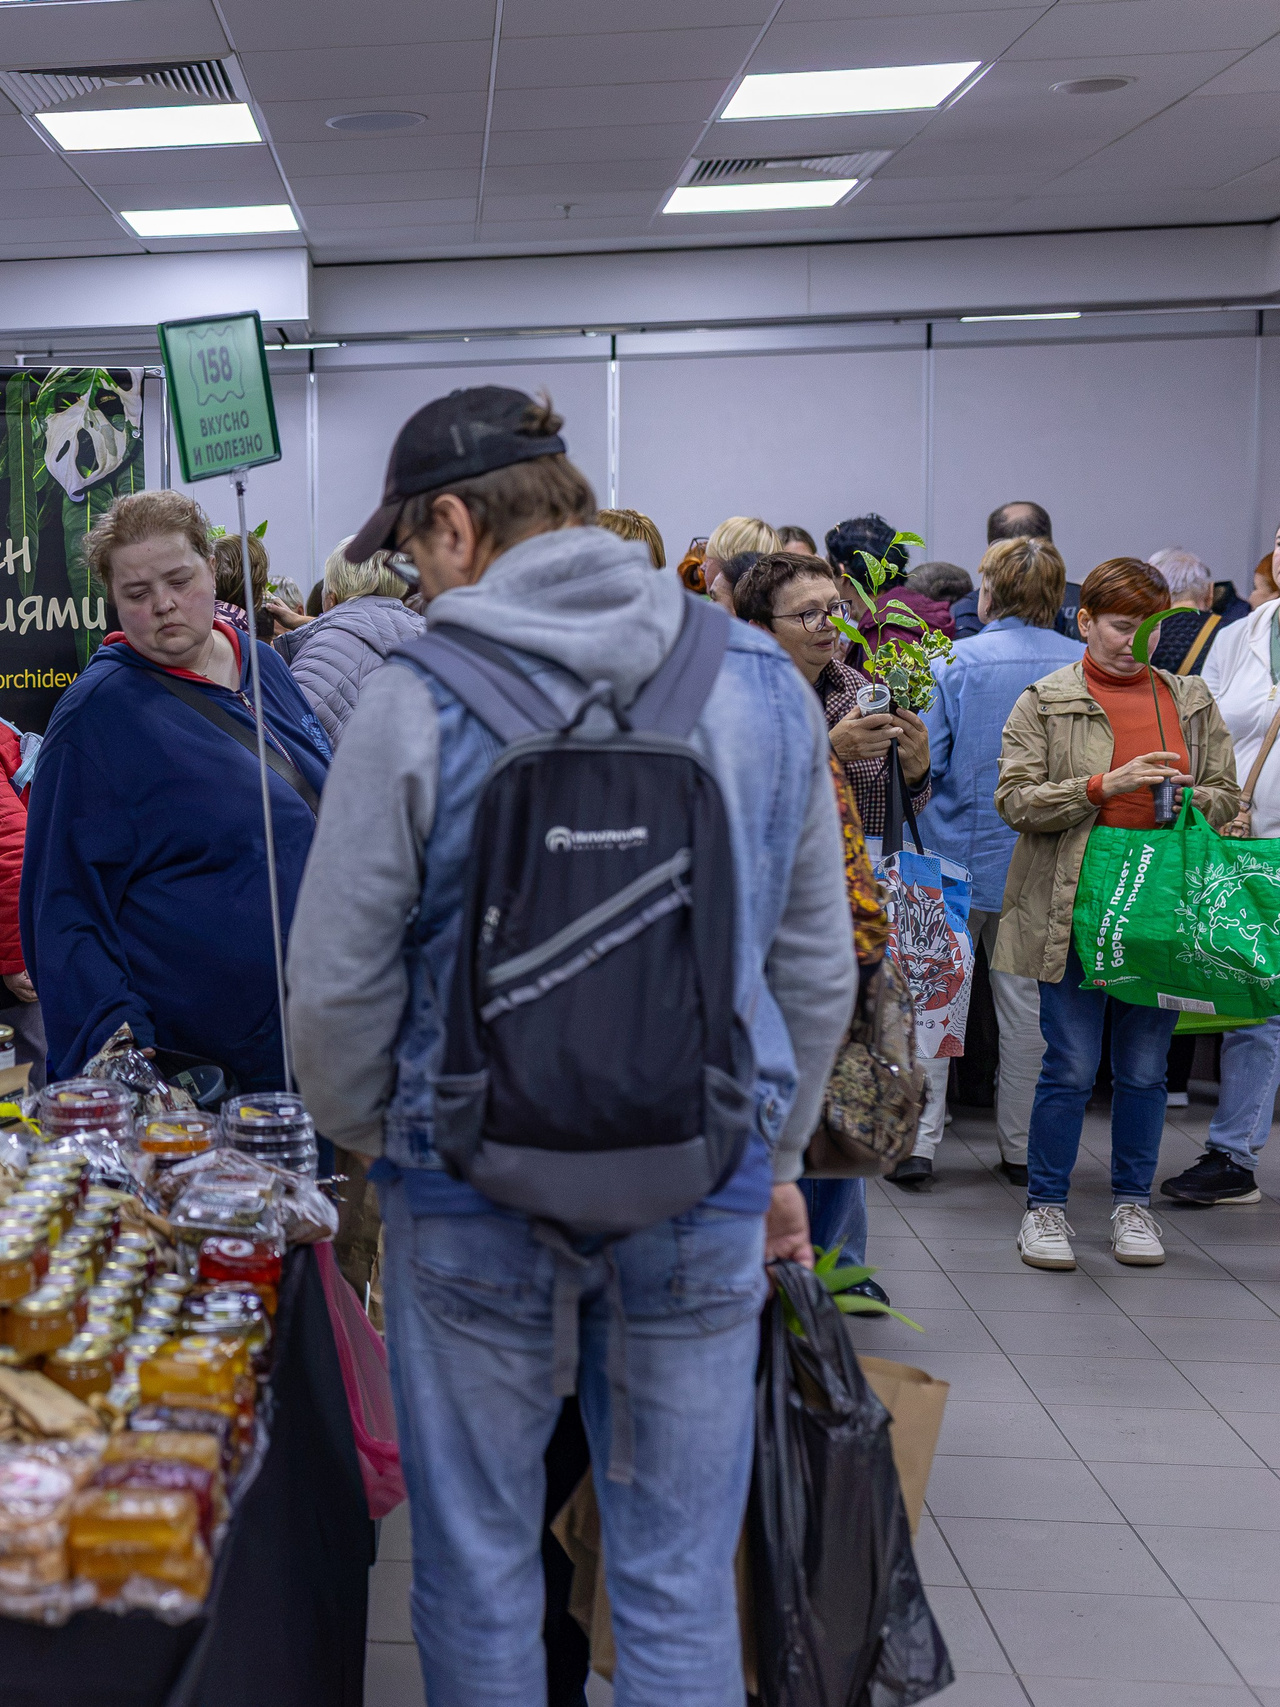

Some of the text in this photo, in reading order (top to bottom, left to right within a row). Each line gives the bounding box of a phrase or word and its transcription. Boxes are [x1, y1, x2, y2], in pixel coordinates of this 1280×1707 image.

[197, 346, 233, 385] 158
[199, 410, 250, 437] ВКУСНО
[193, 433, 263, 466] И ПОЛЕЗНО
[1096, 908, 1116, 947] беру
[1109, 861, 1131, 905] пакет
[1111, 914, 1129, 968] берегу
[1123, 844, 1155, 912] природу
